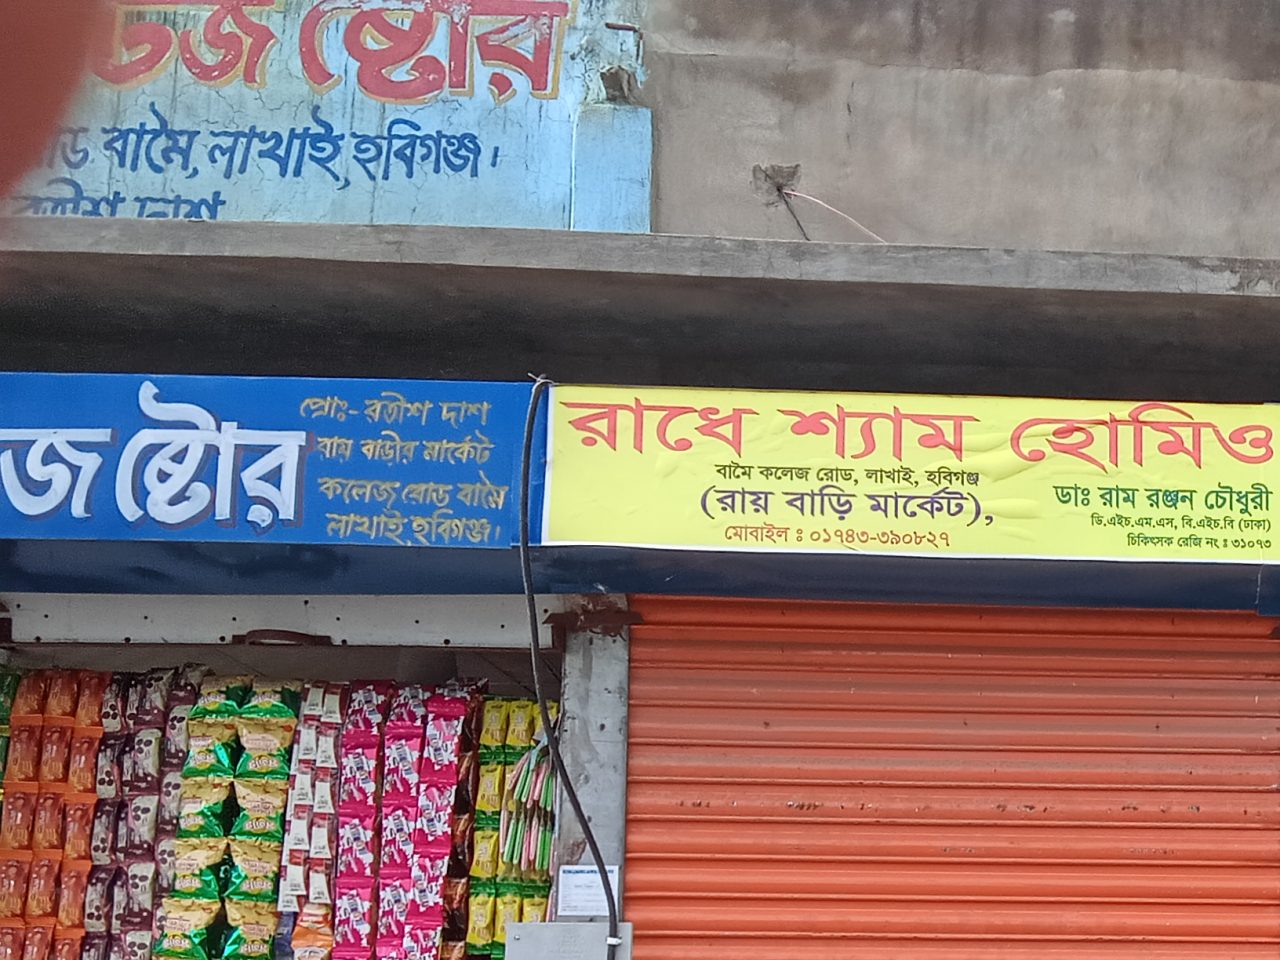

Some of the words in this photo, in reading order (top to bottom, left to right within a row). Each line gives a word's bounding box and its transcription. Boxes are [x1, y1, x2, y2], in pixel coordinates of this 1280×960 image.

[423, 429, 496, 465] মার্কেট
[559, 396, 761, 458] রাধে
[777, 404, 982, 462] শ্যাম
[1010, 401, 1275, 474] হোমিও
[0, 427, 112, 518] জ
[715, 460, 755, 480] বামৈ
[758, 464, 812, 482] কলেজ
[816, 466, 860, 486] রোড,
[865, 465, 920, 488] লাখাই,
[925, 467, 980, 487] হবিগঞ্জ
[700, 485, 775, 520] (রায়
[782, 484, 858, 521] বাড়ি
[864, 486, 994, 527] মার্কেট),
[1053, 483, 1091, 508] ডাঃ
[1097, 483, 1140, 510] রাম
[1145, 487, 1198, 512] রঞ্জন
[1204, 482, 1274, 517] চৌধুরী
[724, 521, 790, 544] মোবাইল
[810, 528, 951, 548] ০১৭৪৩-৩৯০৮২৭
[1127, 532, 1174, 548] চিকিৎসক
[1205, 537, 1220, 549] নং
[1231, 539, 1272, 550] ৩১০৭৩
[1238, 518, 1272, 533] (ঢাকা)
